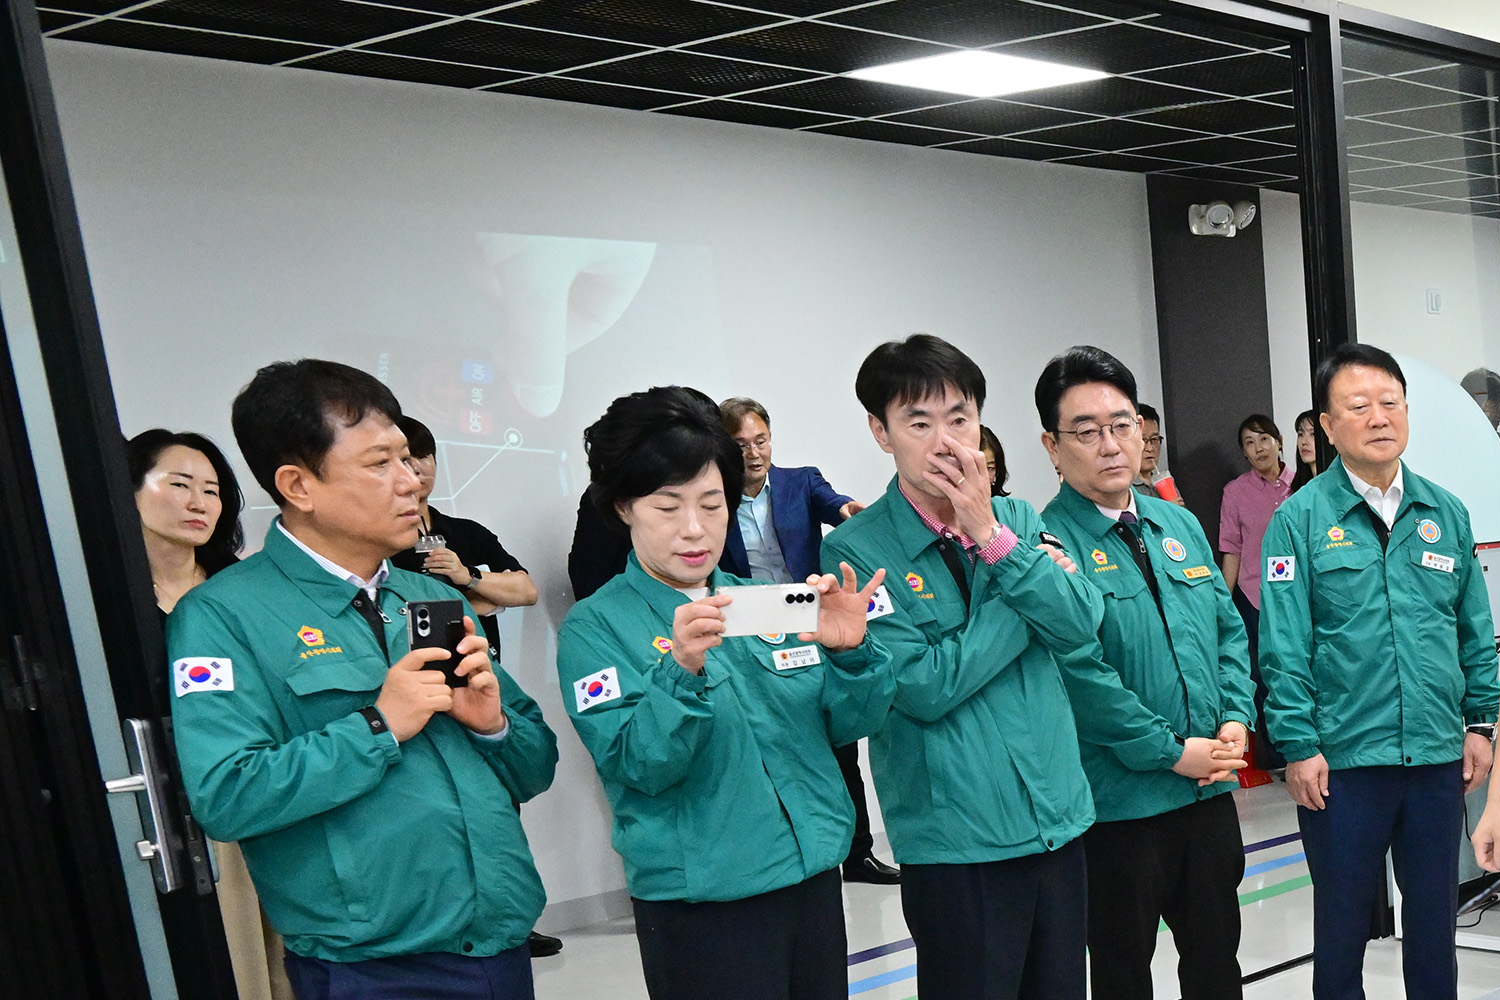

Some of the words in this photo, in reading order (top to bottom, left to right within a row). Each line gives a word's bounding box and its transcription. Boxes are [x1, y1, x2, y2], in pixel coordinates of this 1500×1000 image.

[472, 363, 485, 380] ON
[471, 387, 483, 407] AIR
[469, 410, 482, 433] OFF
